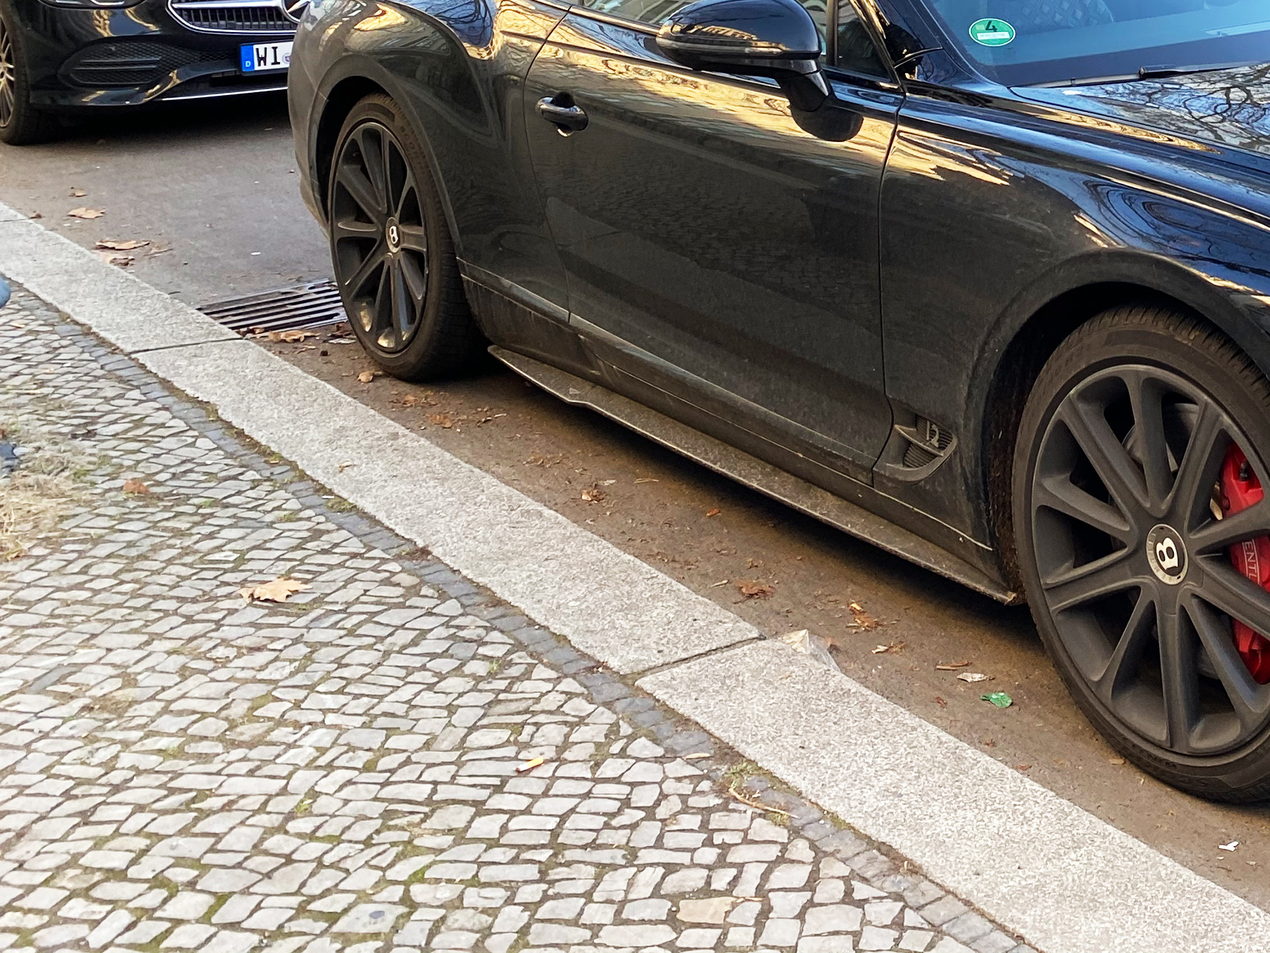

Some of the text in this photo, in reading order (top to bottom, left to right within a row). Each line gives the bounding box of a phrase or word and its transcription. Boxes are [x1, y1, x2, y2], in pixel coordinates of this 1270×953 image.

[985, 20, 998, 33] 4
[245, 46, 281, 68] D WI
